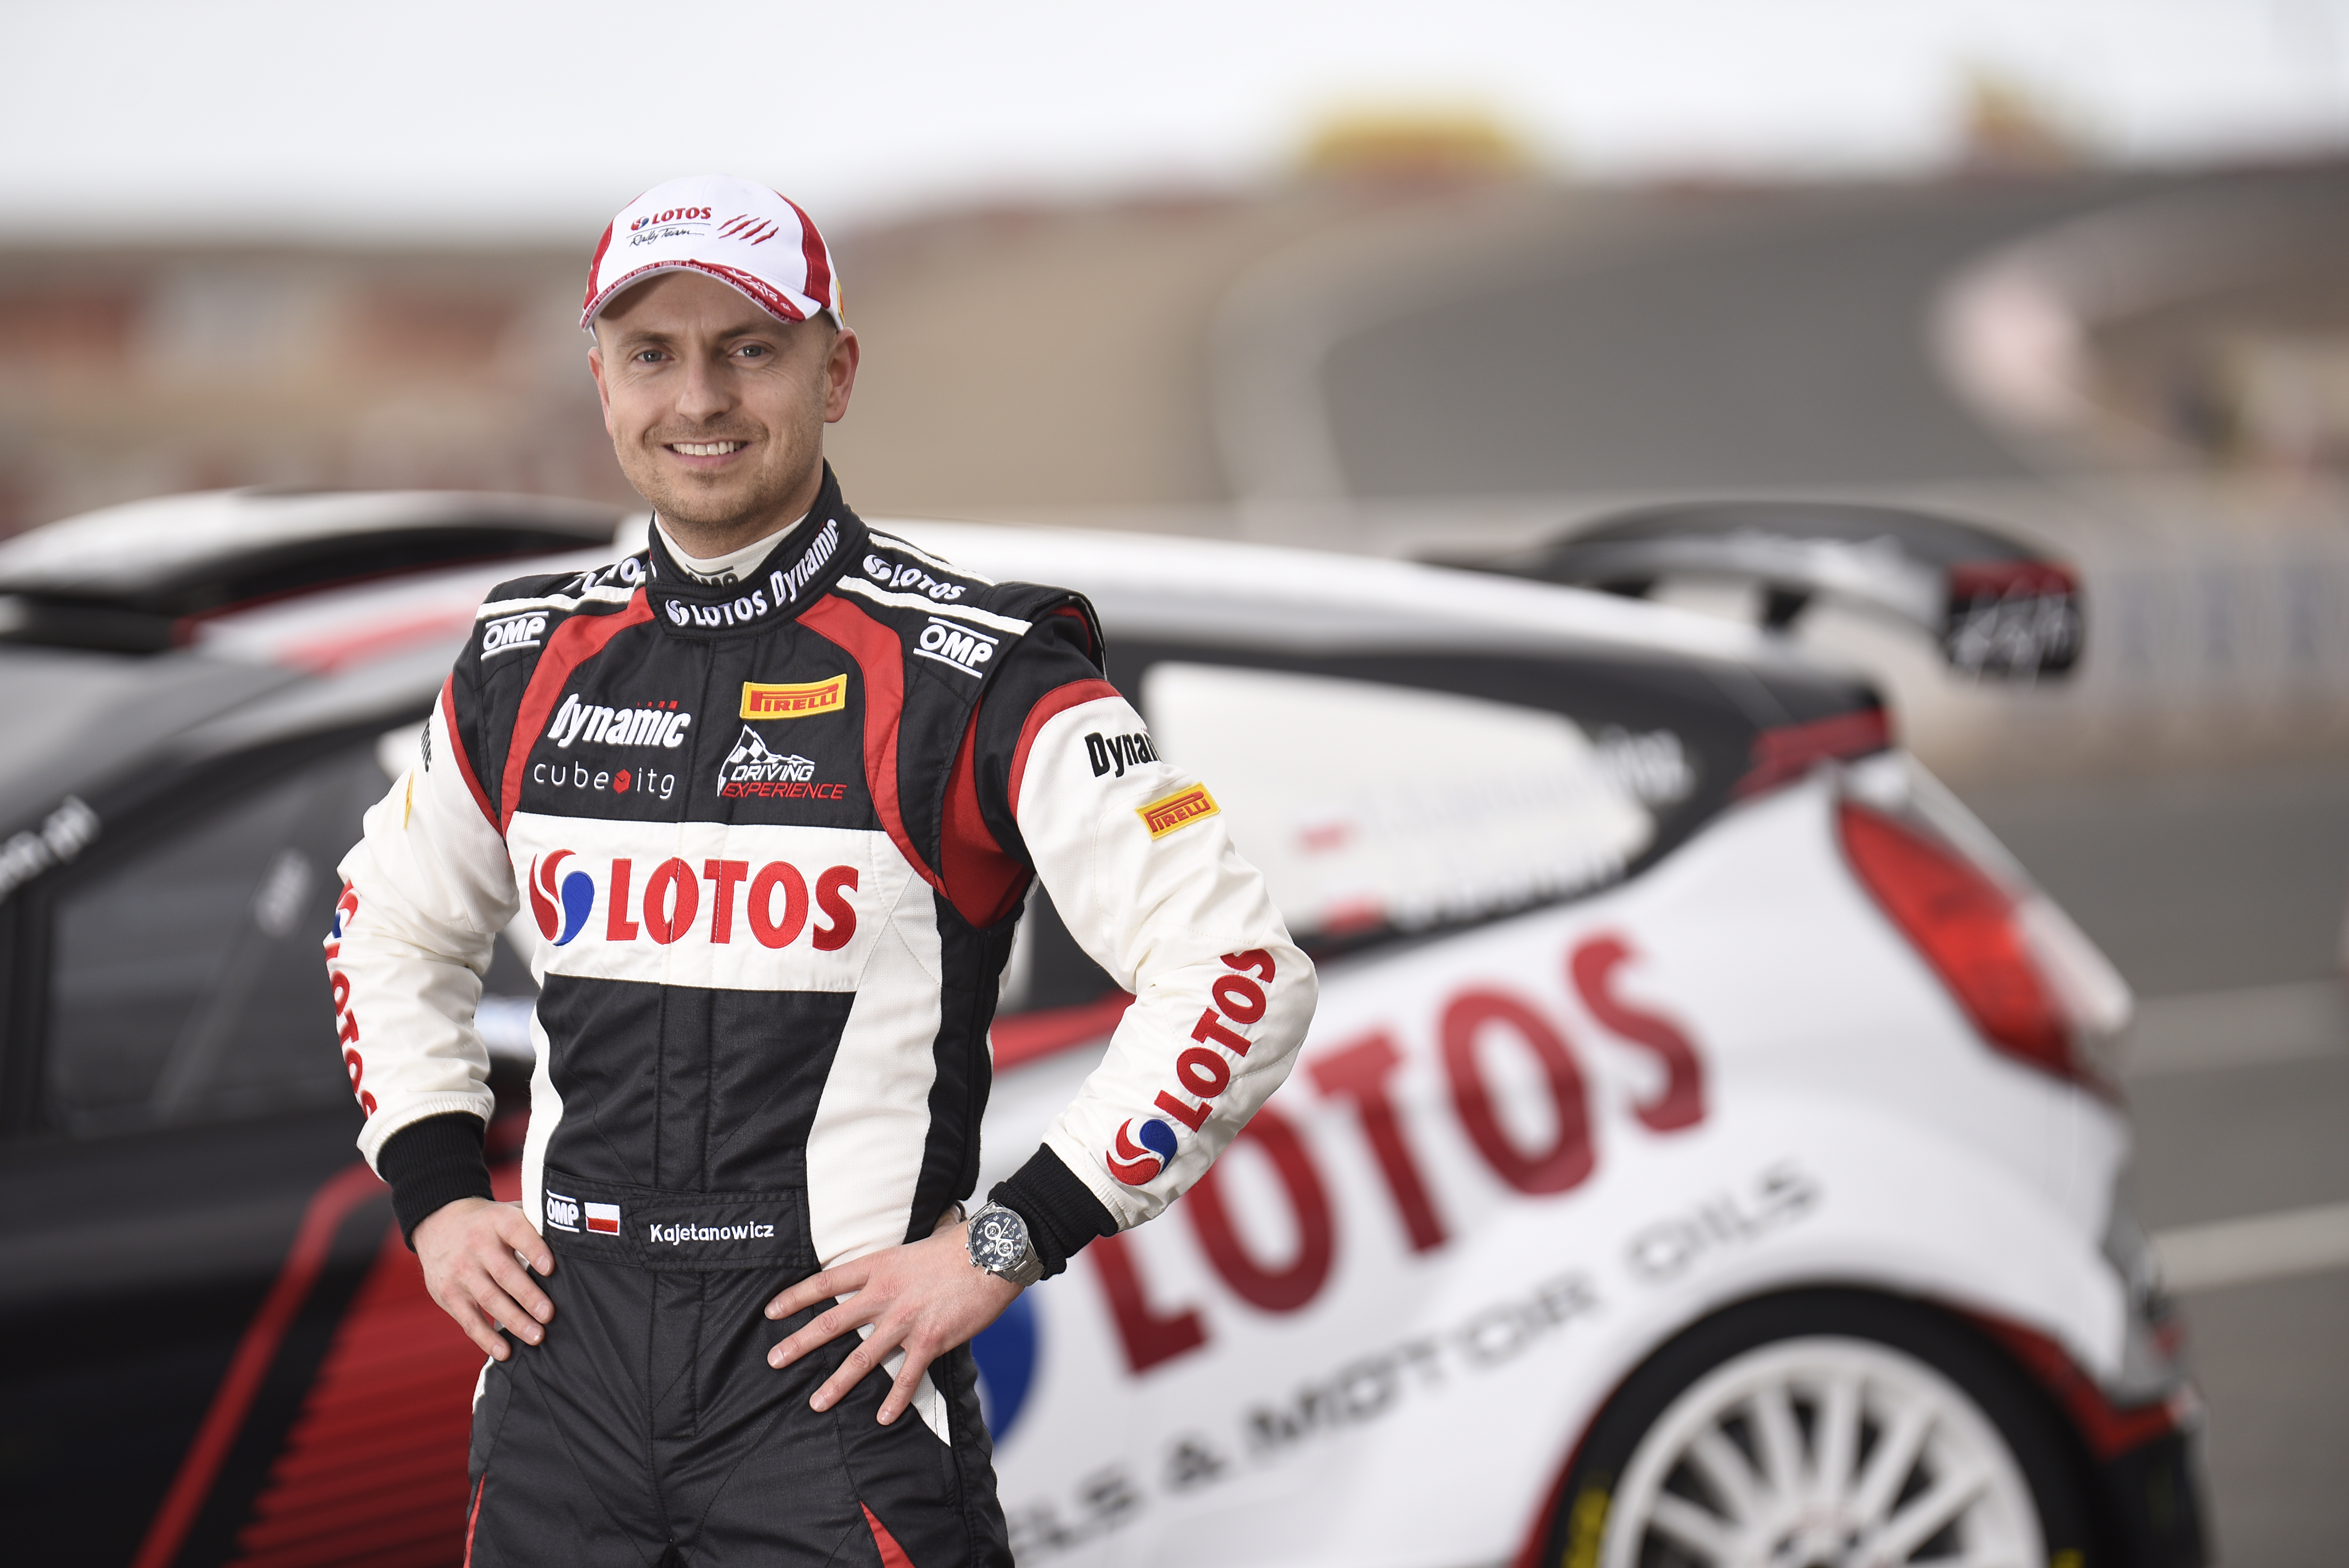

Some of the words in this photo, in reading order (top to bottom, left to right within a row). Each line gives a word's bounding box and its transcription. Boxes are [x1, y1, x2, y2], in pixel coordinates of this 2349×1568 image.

[652, 207, 711, 225] LOTOS
[629, 230, 659, 247] Rally
[658, 227, 704, 237] Team
[690, 589, 768, 626] LOTOS
[770, 518, 839, 607] Dynamic
[889, 563, 966, 600] LOTOS
[483, 617, 546, 650] OMP
[920, 624, 993, 666] OMP
[749, 683, 839, 712] PIRELLI
[534, 761, 609, 790] cube
[636, 767, 675, 799] itg
[730, 763, 815, 781] DRIVING
[721, 782, 847, 800] EXPERIENCE
[1144, 791, 1211, 833] PIRELLI
[606, 857, 859, 951] LOTOS
[1153, 948, 1276, 1133] LOTOS
[1084, 925, 1712, 1380] LOTOS
[546, 1197, 579, 1226] OMP
[649, 1221, 774, 1245] Kajetanowicz
[1246, 1269, 1599, 1458] MOTOR
[1626, 1160, 1821, 1285] OILS
